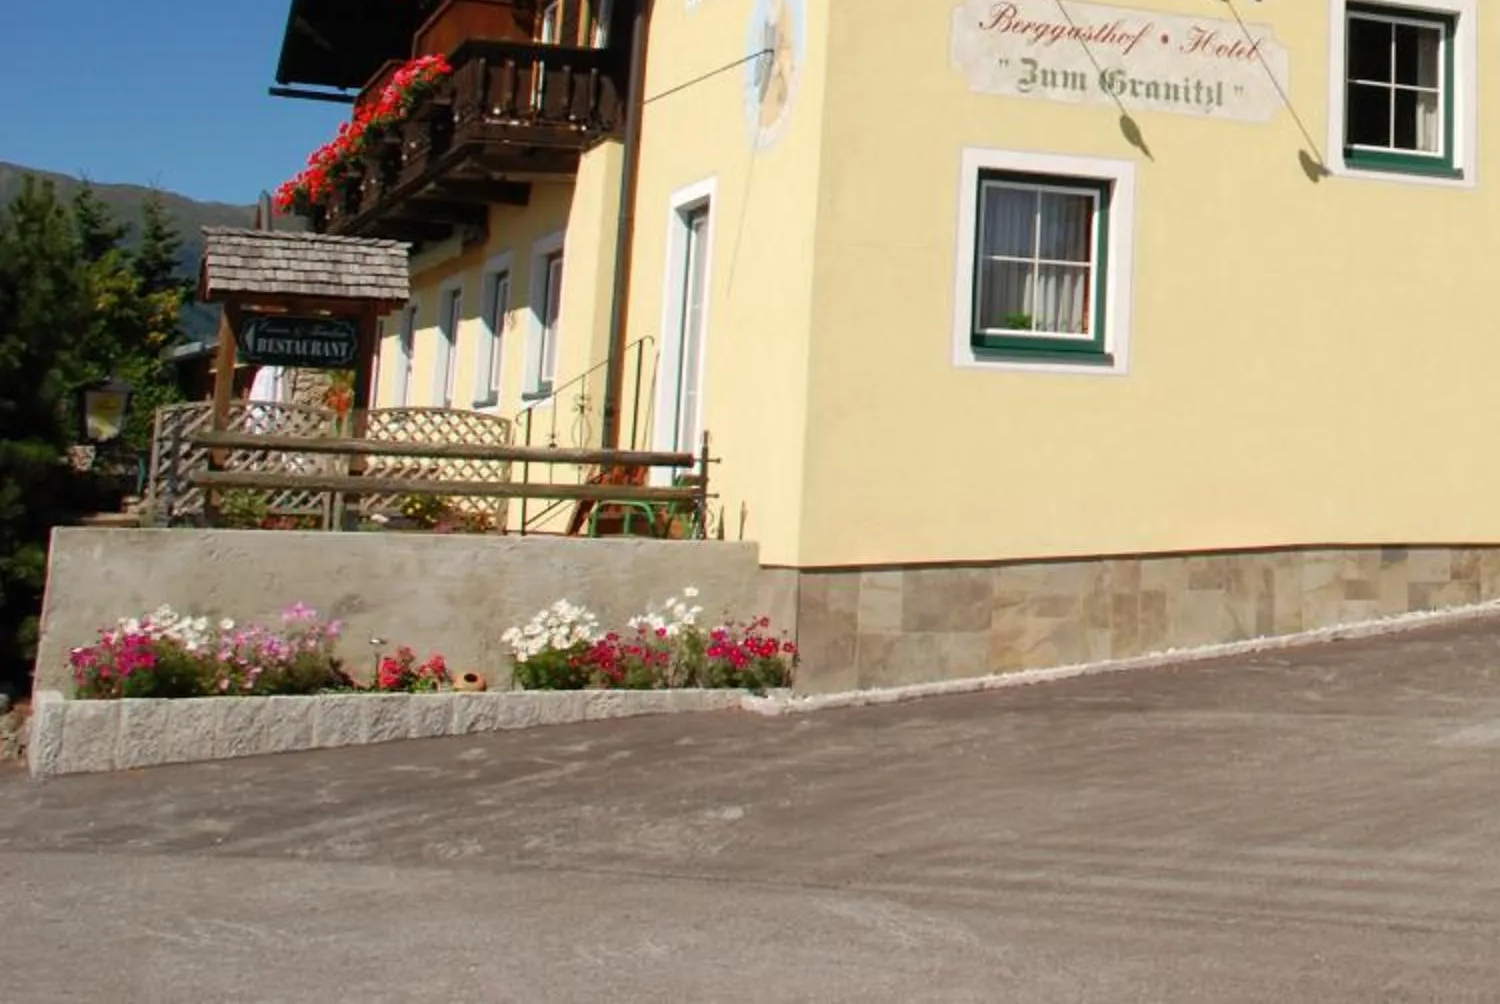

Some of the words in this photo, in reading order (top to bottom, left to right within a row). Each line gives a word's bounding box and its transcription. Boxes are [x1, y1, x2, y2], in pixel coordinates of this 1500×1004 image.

[979, 2, 1153, 55] Berggasthof
[1179, 26, 1262, 59] Hotel
[1017, 56, 1088, 93] Zum
[1099, 68, 1223, 114] Granitzl
[256, 337, 349, 357] RESTAURANT
